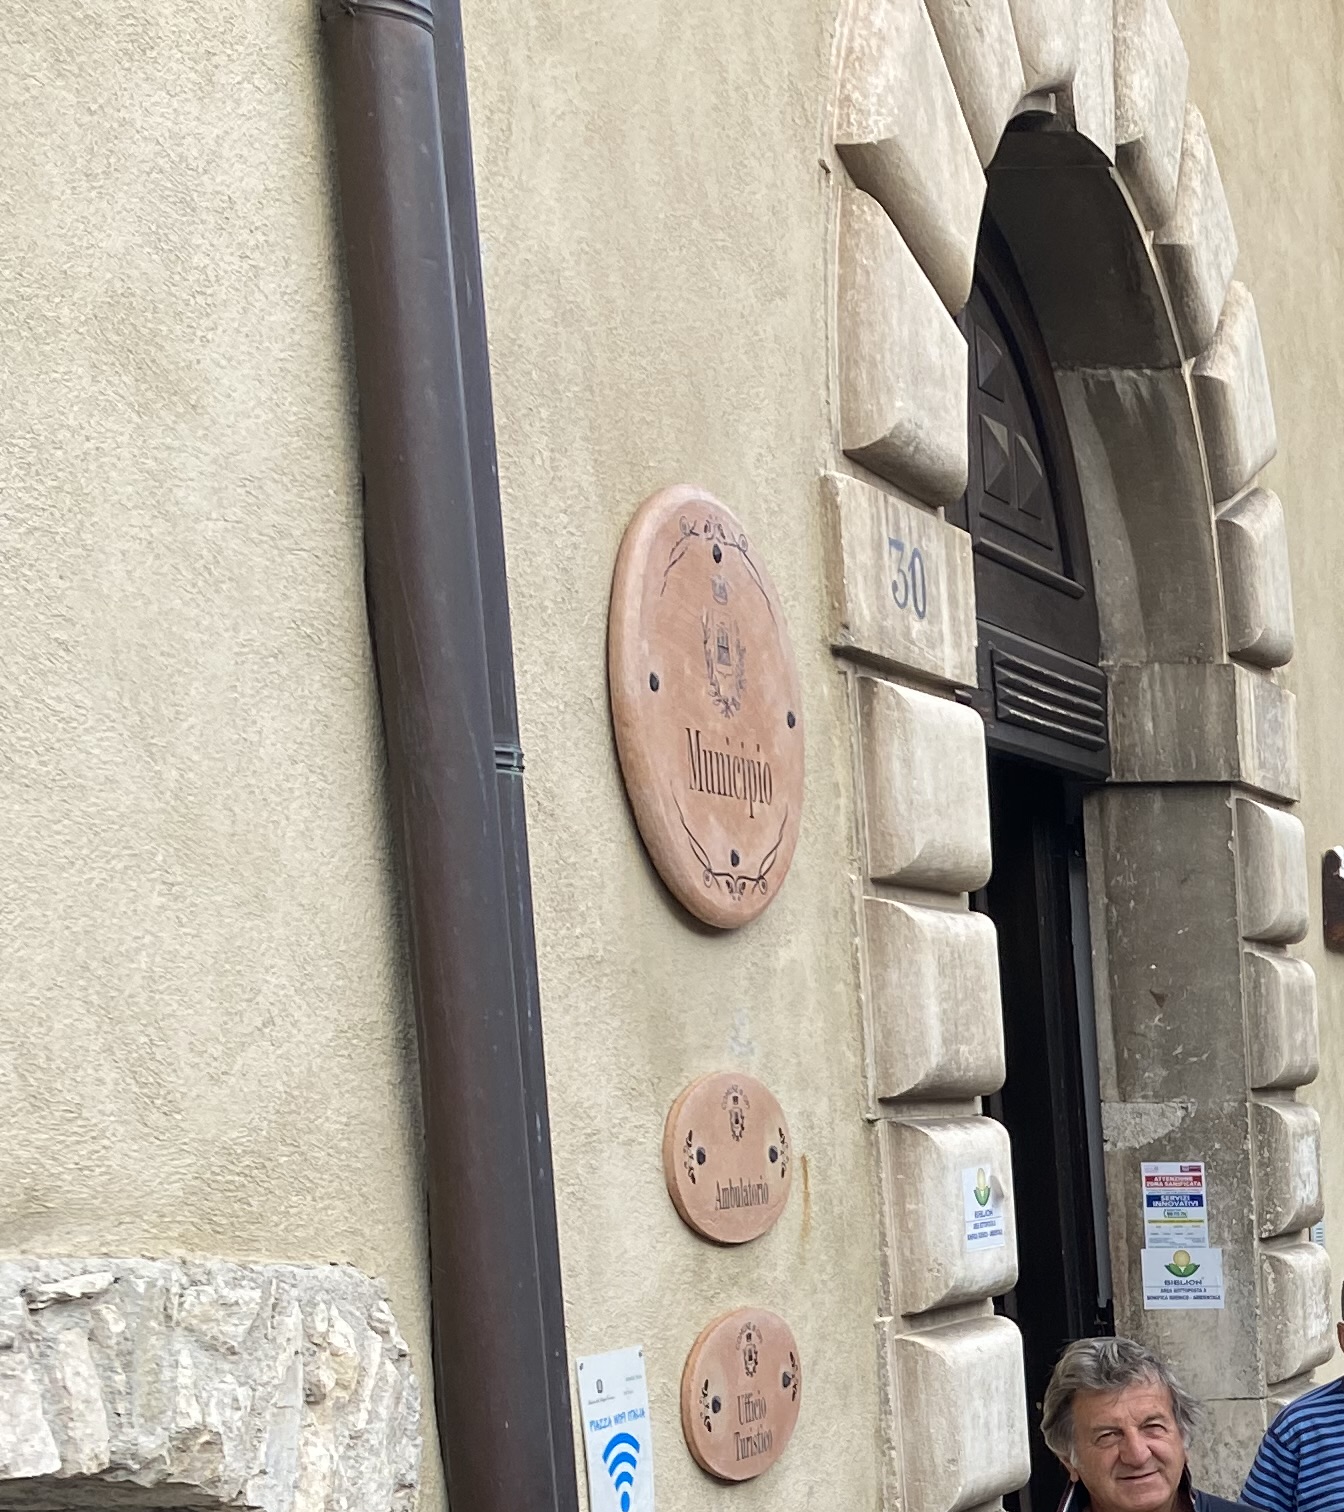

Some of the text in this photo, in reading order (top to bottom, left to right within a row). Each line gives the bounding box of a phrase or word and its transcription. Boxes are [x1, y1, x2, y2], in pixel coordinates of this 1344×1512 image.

[888, 537, 926, 619] 30
[685, 728, 772, 819] Municipio
[715, 1175, 769, 1211] Ambulatorio
[737, 1390, 767, 1426] Ufficio
[734, 1424, 773, 1462] Turistico
